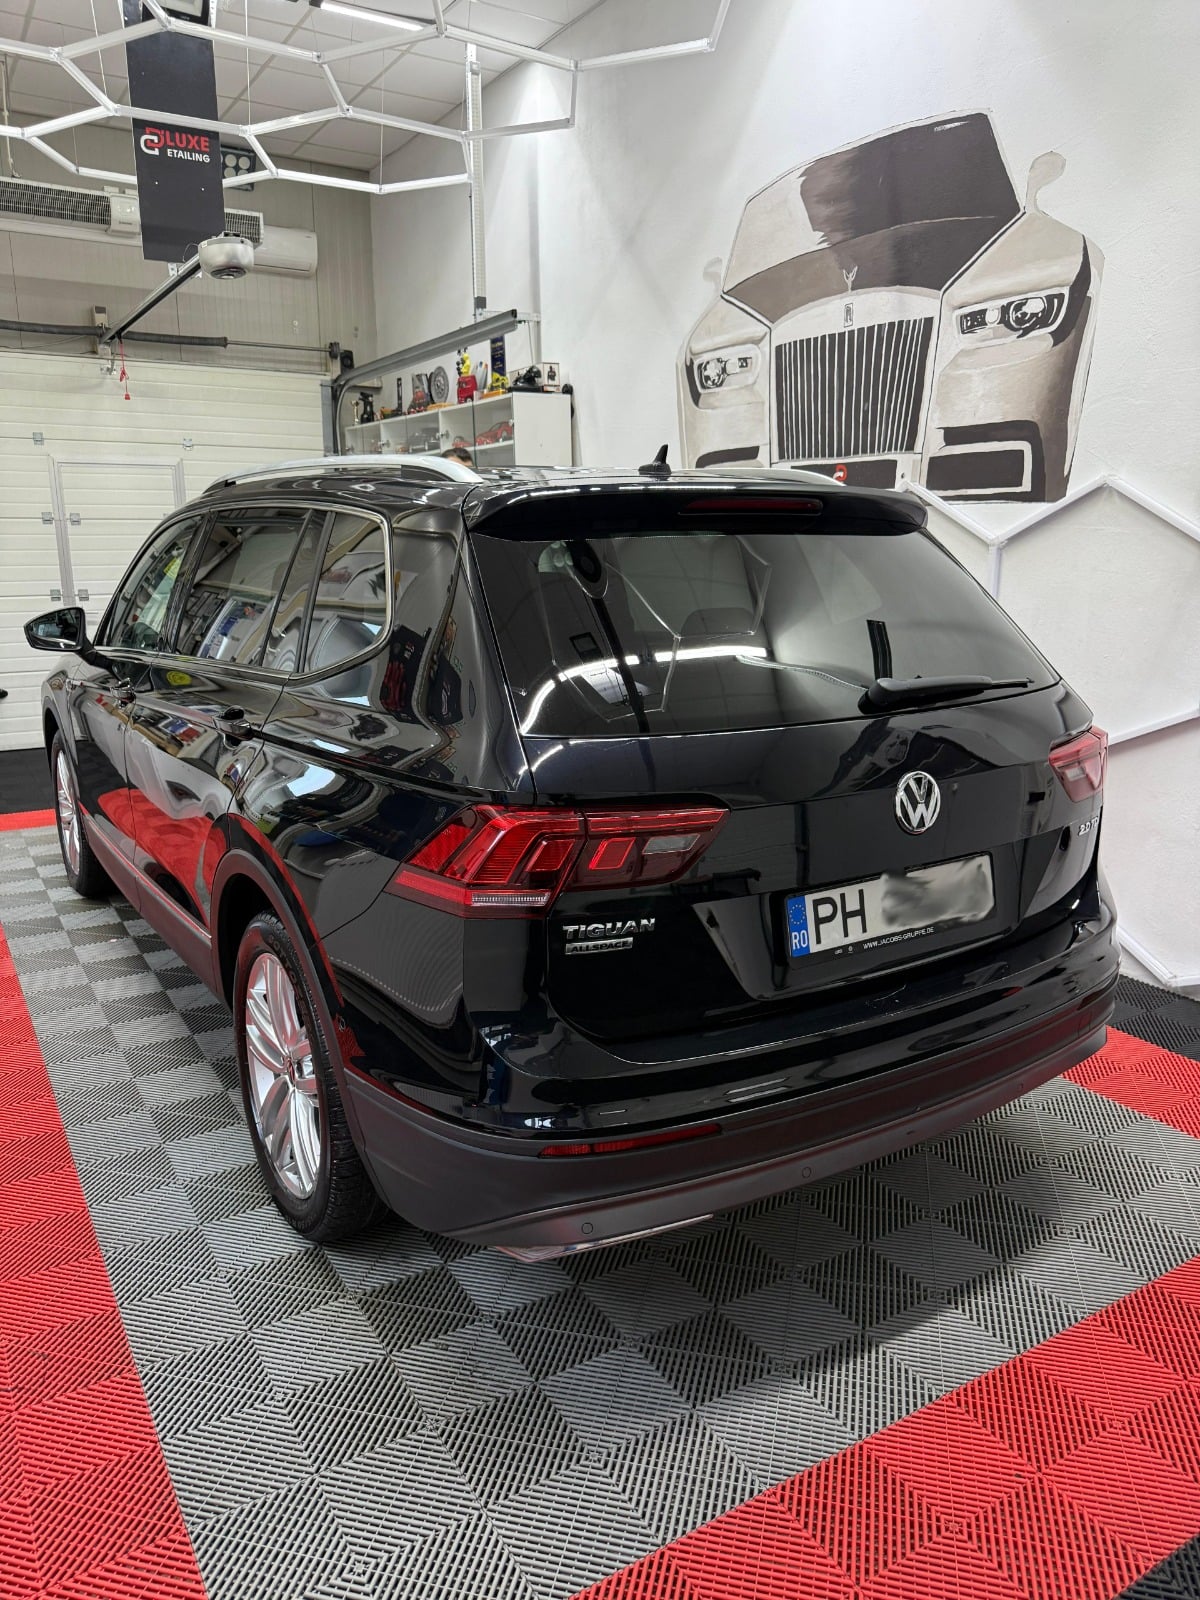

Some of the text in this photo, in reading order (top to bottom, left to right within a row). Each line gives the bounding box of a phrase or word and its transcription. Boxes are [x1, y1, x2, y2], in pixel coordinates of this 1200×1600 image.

[811, 888, 868, 945] PH
[562, 917, 656, 940] TIGUAN
[569, 939, 630, 954] ALLSPACE
[791, 930, 809, 950] RO
